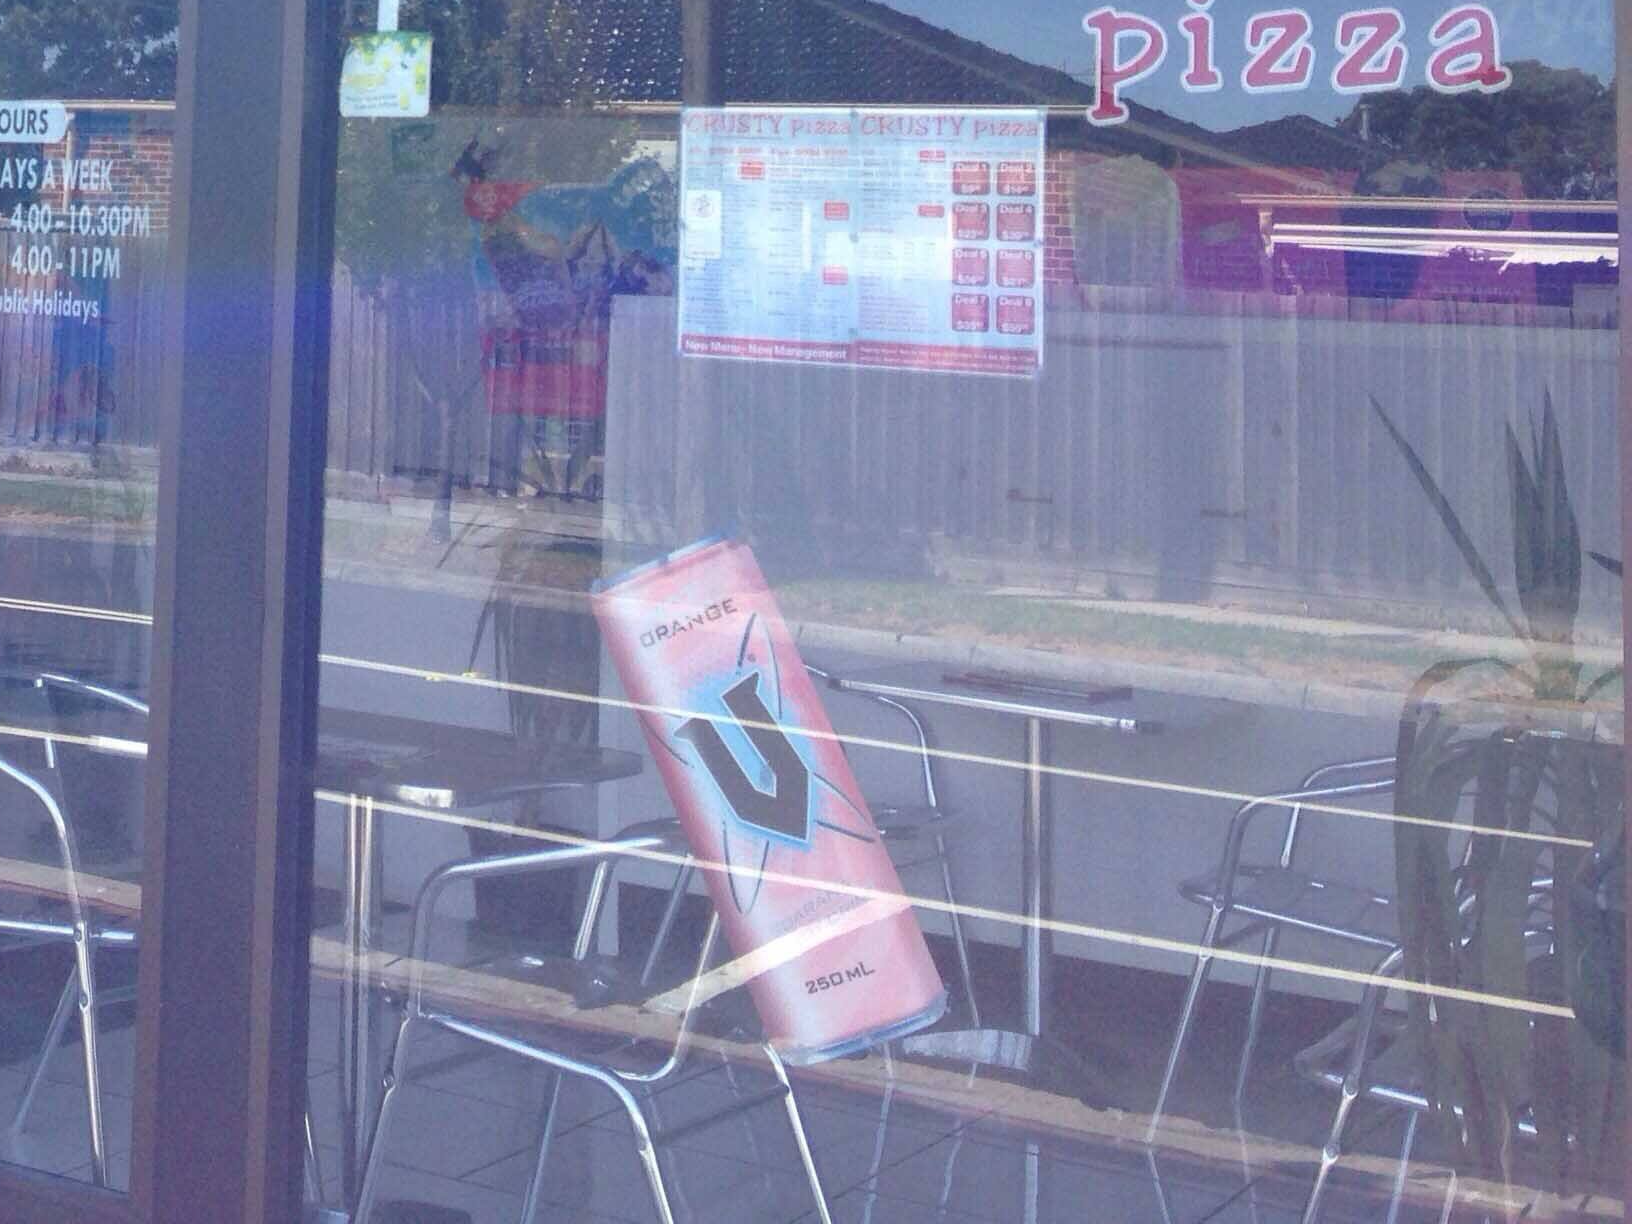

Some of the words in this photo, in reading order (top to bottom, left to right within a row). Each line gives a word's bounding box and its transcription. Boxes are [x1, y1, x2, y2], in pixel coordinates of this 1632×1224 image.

[860, 115, 966, 137] CRUSTY
[41, 160, 56, 190] A
[59, 159, 114, 193] WEEK
[10, 203, 53, 234] 4.00
[68, 204, 151, 238] 10.30PM
[10, 245, 53, 277] 4.00
[70, 247, 121, 279] 11PM
[32, 289, 100, 324] Holidays
[639, 597, 739, 649] ORANGE
